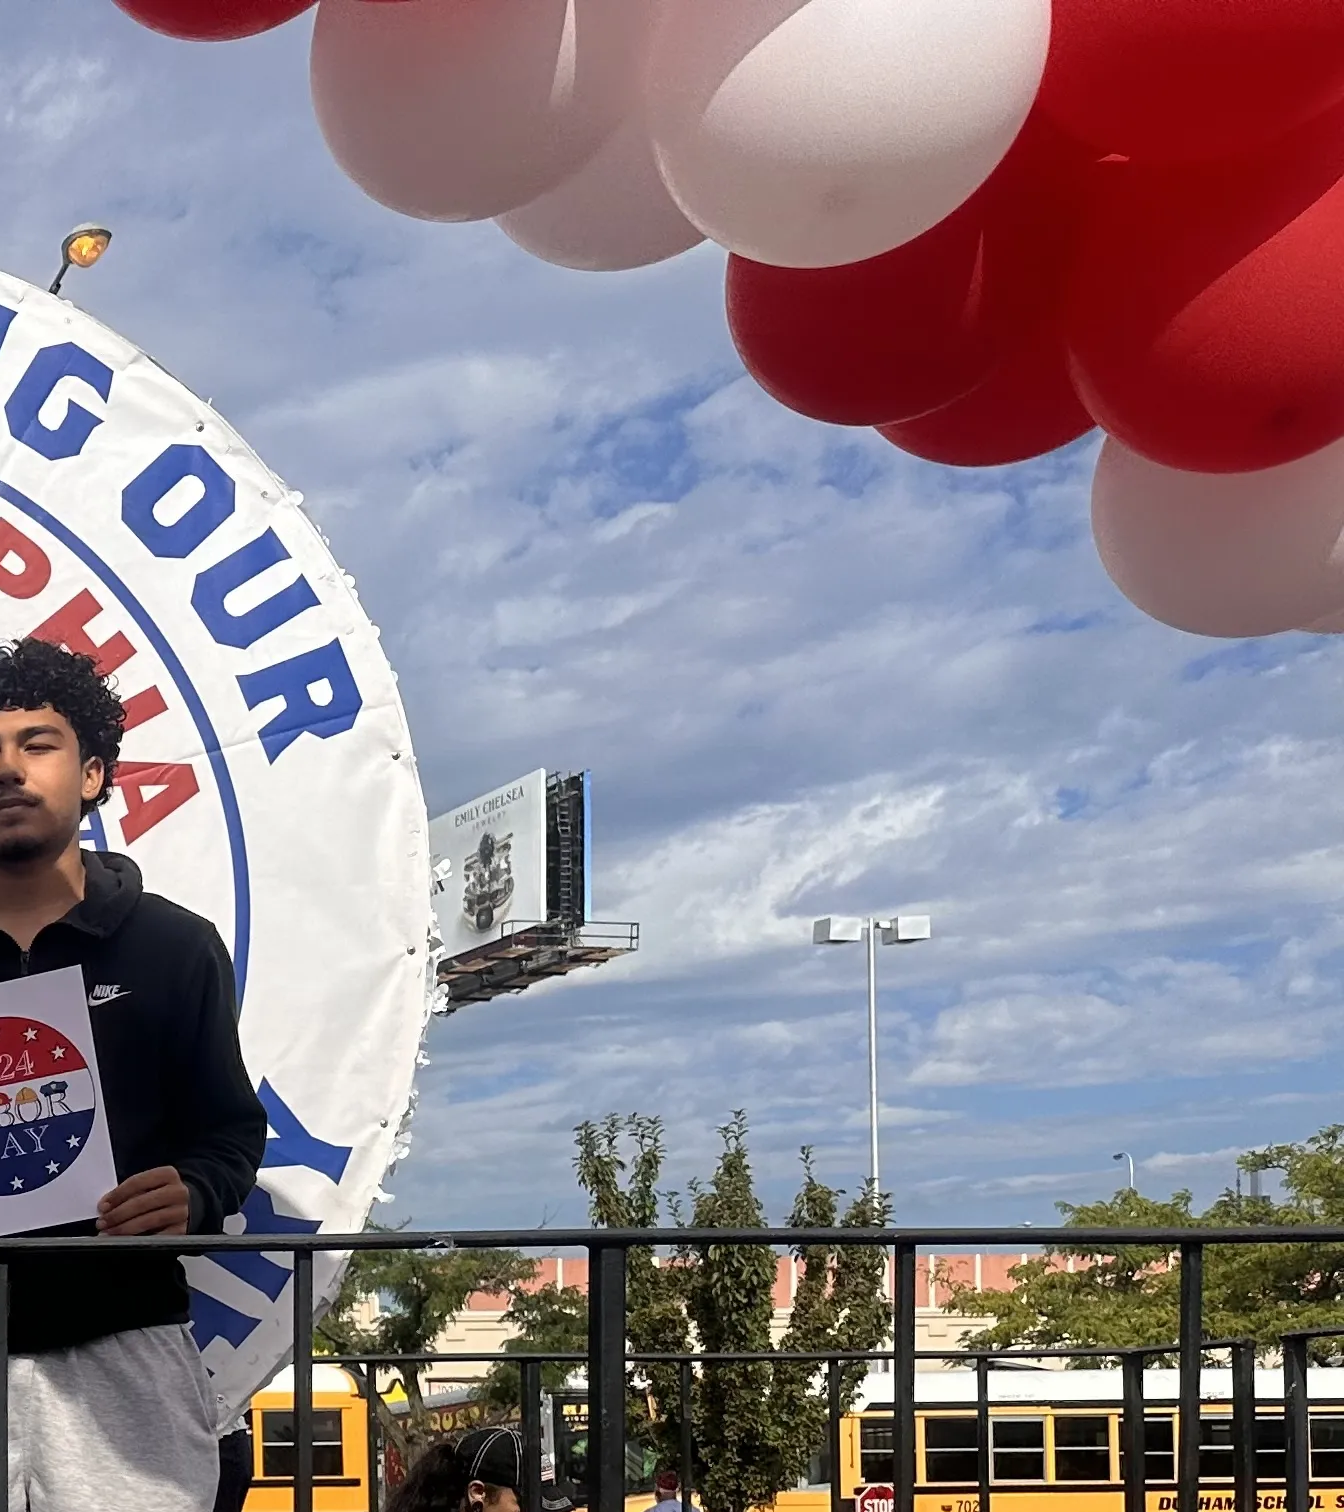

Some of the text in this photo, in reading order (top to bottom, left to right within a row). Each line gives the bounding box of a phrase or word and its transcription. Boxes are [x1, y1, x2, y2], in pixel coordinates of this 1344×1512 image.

[121, 443, 364, 765] OUR
[455, 785, 525, 828] EMILY CHELSEA
[92, 984, 121, 998] NIKE
[1158, 1496, 1236, 1511] DHAM
[1256, 1495, 1325, 1510] SCHL
